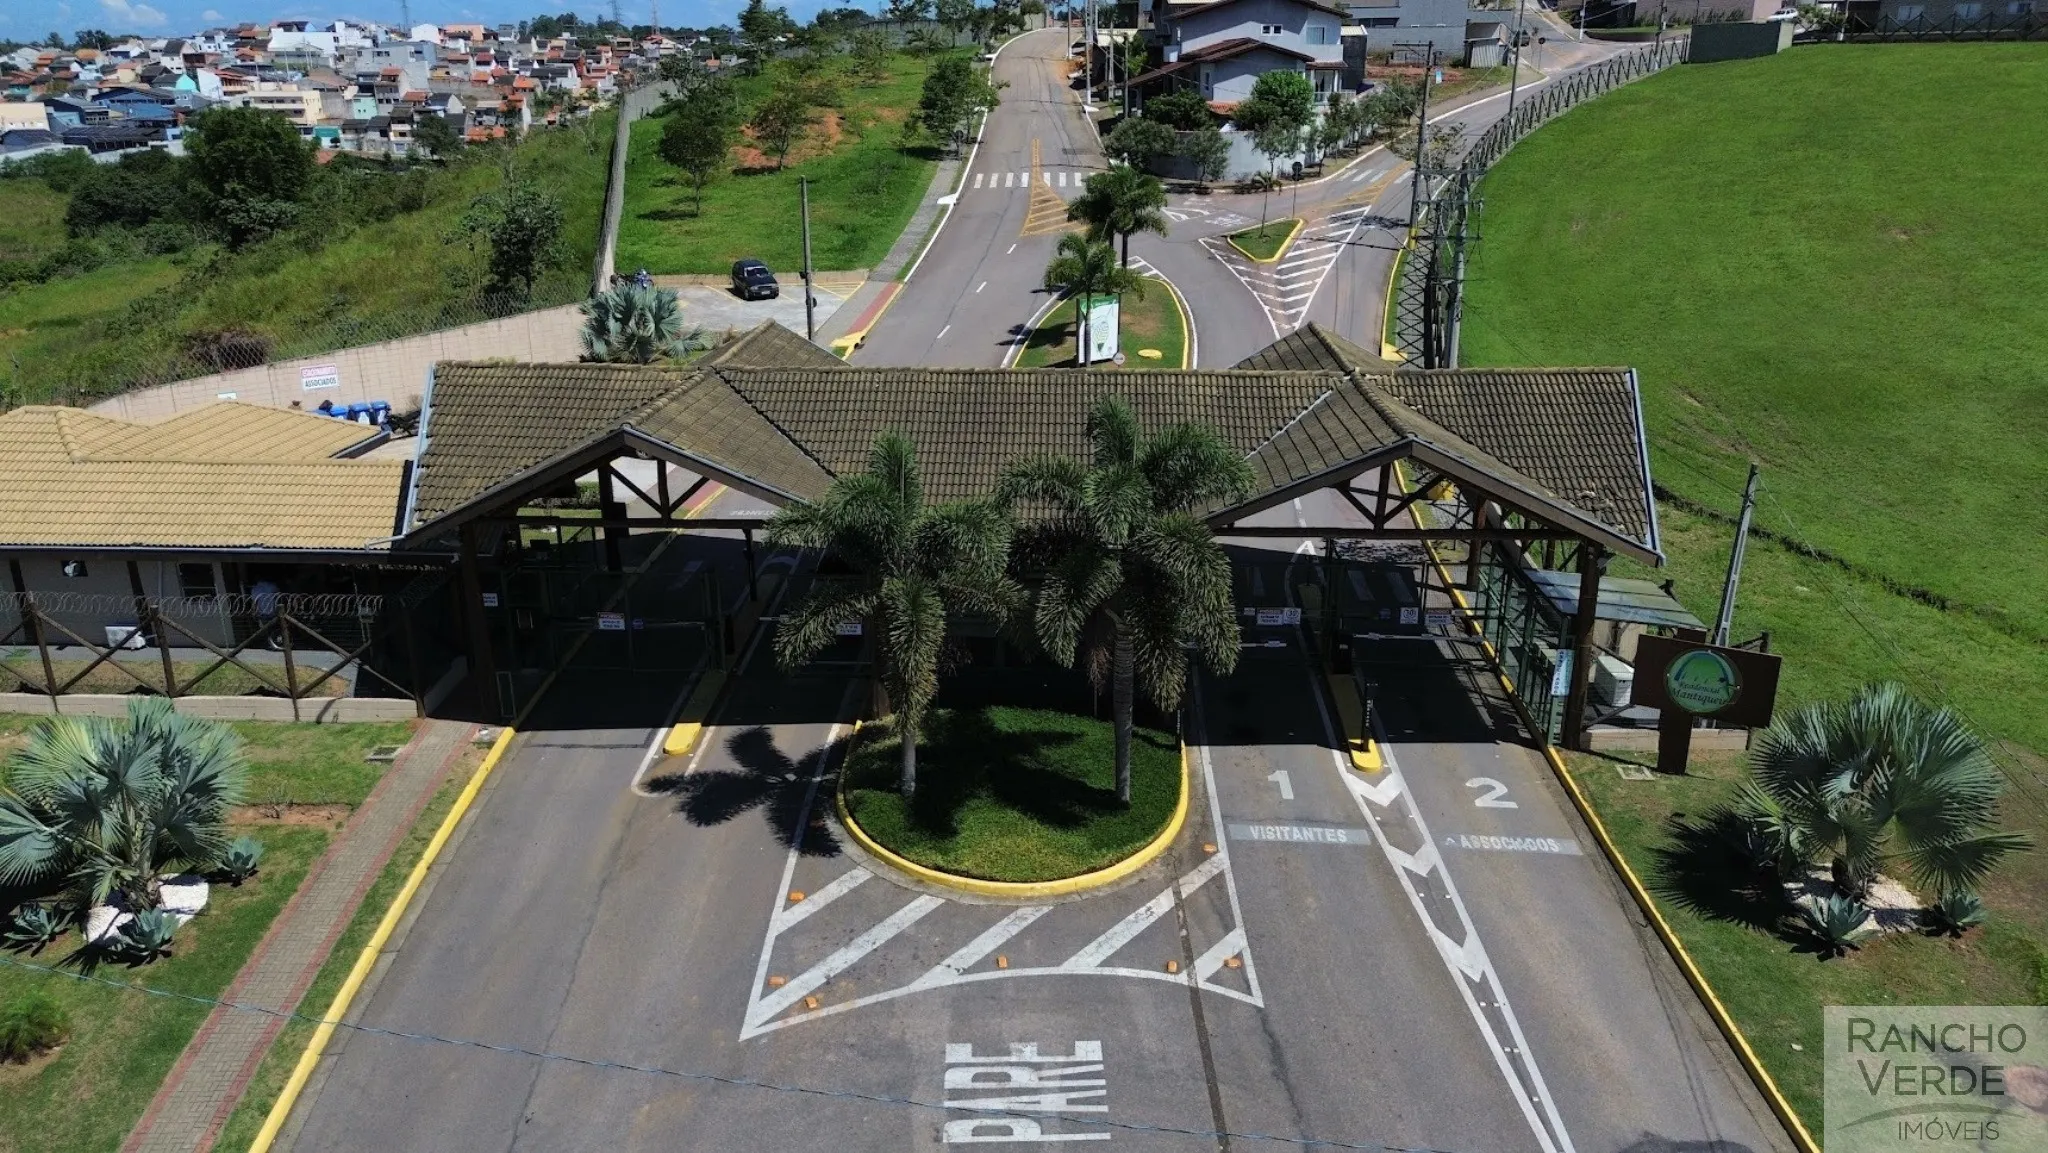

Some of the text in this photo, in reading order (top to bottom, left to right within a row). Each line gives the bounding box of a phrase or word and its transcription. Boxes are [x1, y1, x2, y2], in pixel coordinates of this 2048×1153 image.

[1268, 770, 1294, 800] 1
[1465, 777, 1519, 809] 2
[1249, 826, 1348, 843] VISITANTES
[943, 1040, 1112, 1143] PARE
